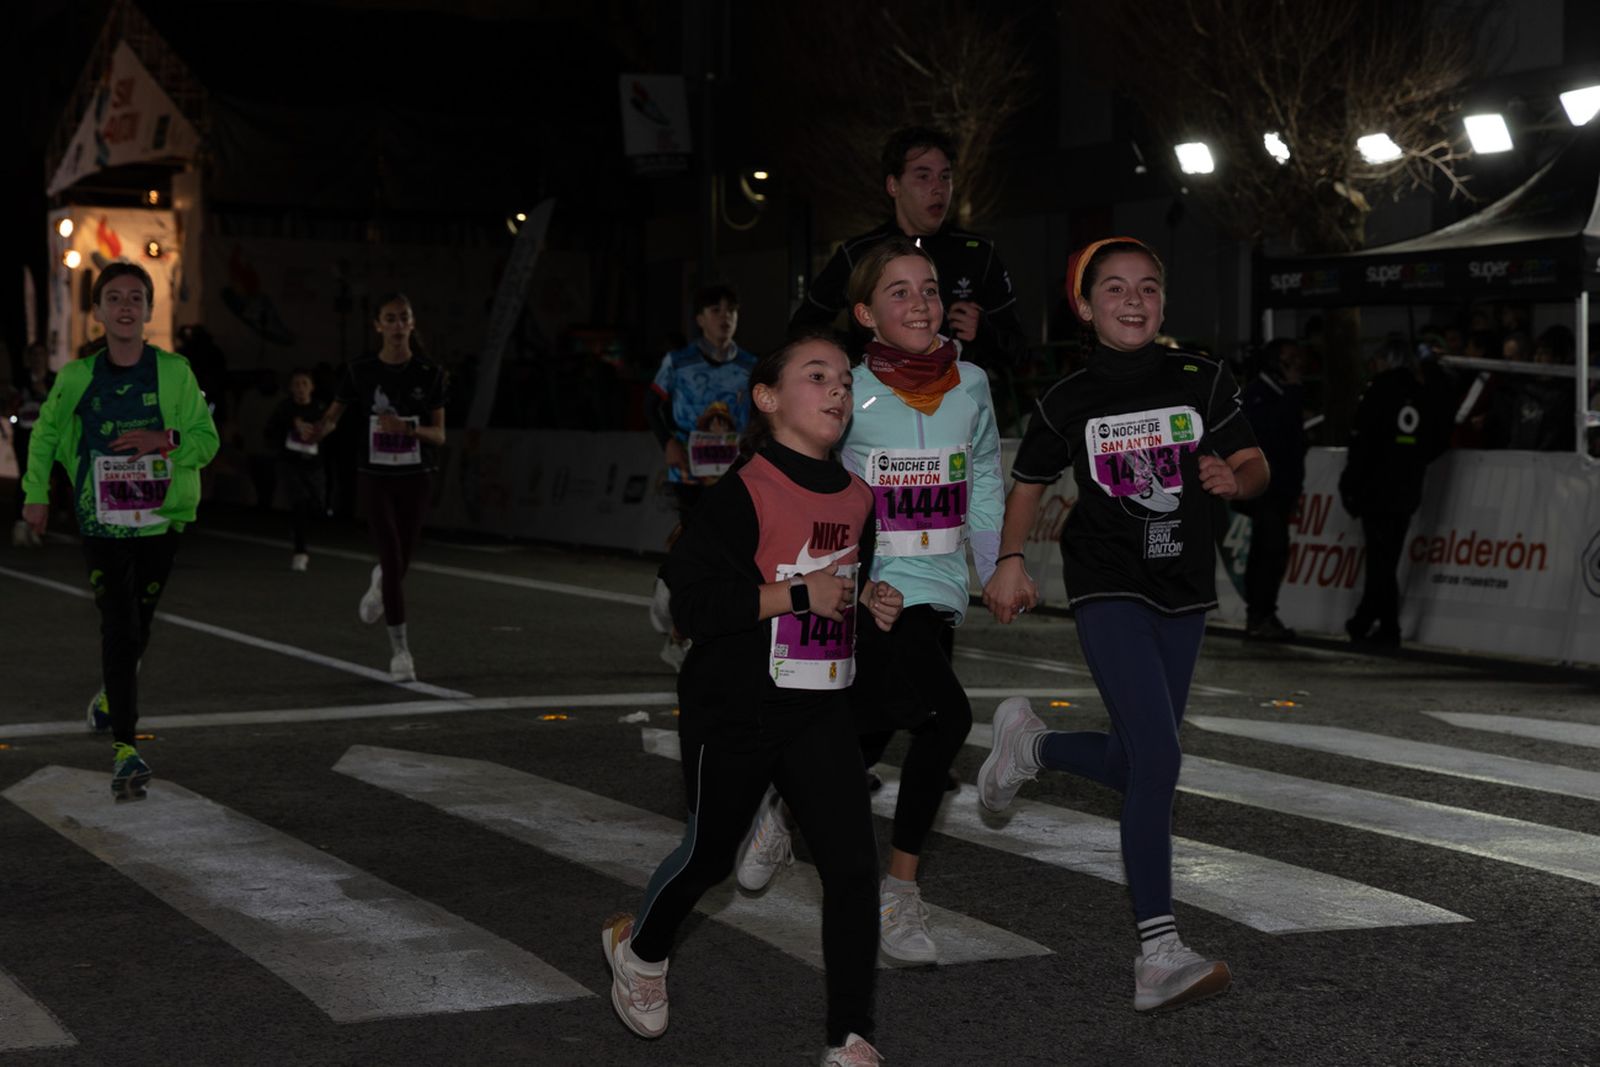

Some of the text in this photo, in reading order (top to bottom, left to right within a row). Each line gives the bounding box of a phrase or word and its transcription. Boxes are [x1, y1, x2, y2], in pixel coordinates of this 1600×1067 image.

[1365, 264, 1403, 288] super
[1468, 260, 1509, 284] super
[1270, 272, 1303, 295] super
[1112, 424, 1147, 438] NOCHE
[1149, 422, 1160, 433] DE
[1101, 441, 1123, 453] SAN
[1126, 433, 1162, 450] ANTÓN
[113, 462, 146, 471] NOCHE DE
[890, 461, 925, 471] NOCHE
[927, 460, 940, 471] DE
[879, 474, 900, 485] SAN
[902, 471, 940, 485] ANTÓN
[883, 485, 960, 519] 14441
[810, 522, 850, 550] NIKE
[1148, 533, 1170, 544] SAN
[1148, 540, 1184, 554] ANTÓN
[1409, 530, 1546, 570] calderón
[1286, 532, 1366, 588] NTÓN
[1462, 576, 1509, 589] maestras
